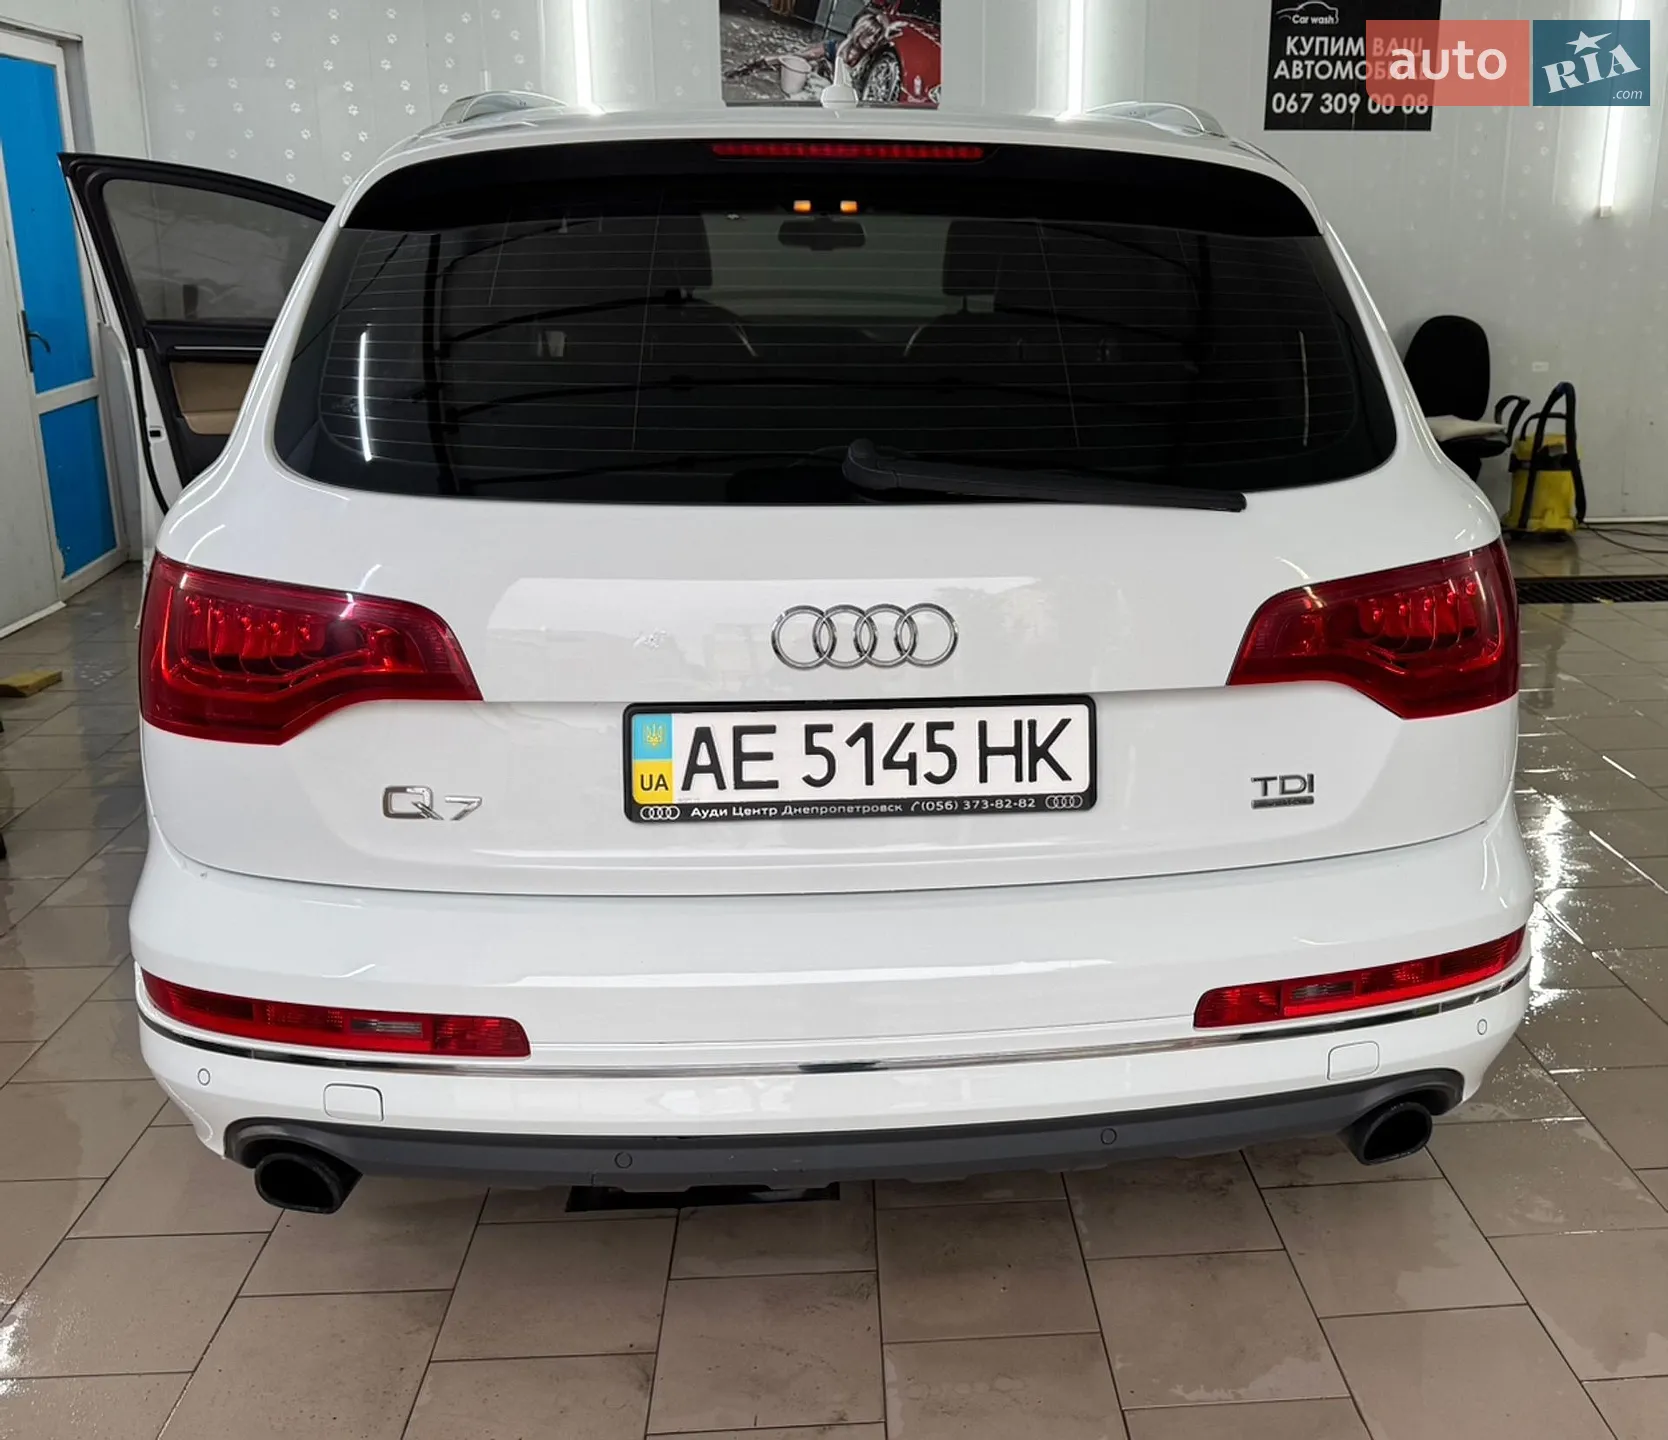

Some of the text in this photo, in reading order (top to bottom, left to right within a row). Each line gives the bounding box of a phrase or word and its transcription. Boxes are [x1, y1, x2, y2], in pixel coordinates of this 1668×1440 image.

[1292, 14, 1334, 24] Car wash
[1286, 36, 1423, 57] КУПИМ ВАШ
[1273, 60, 1431, 80] АВТОМОБ
[1272, 92, 1429, 114] 067 309 00 08
[681, 718, 1073, 791] AE 5145 HK
[640, 774, 669, 792] UA
[1250, 773, 1315, 797] TDI
[382, 785, 483, 821] Q7
[690, 798, 1036, 818] Ауди Центр Днепропетровск (056) 373-82-82
